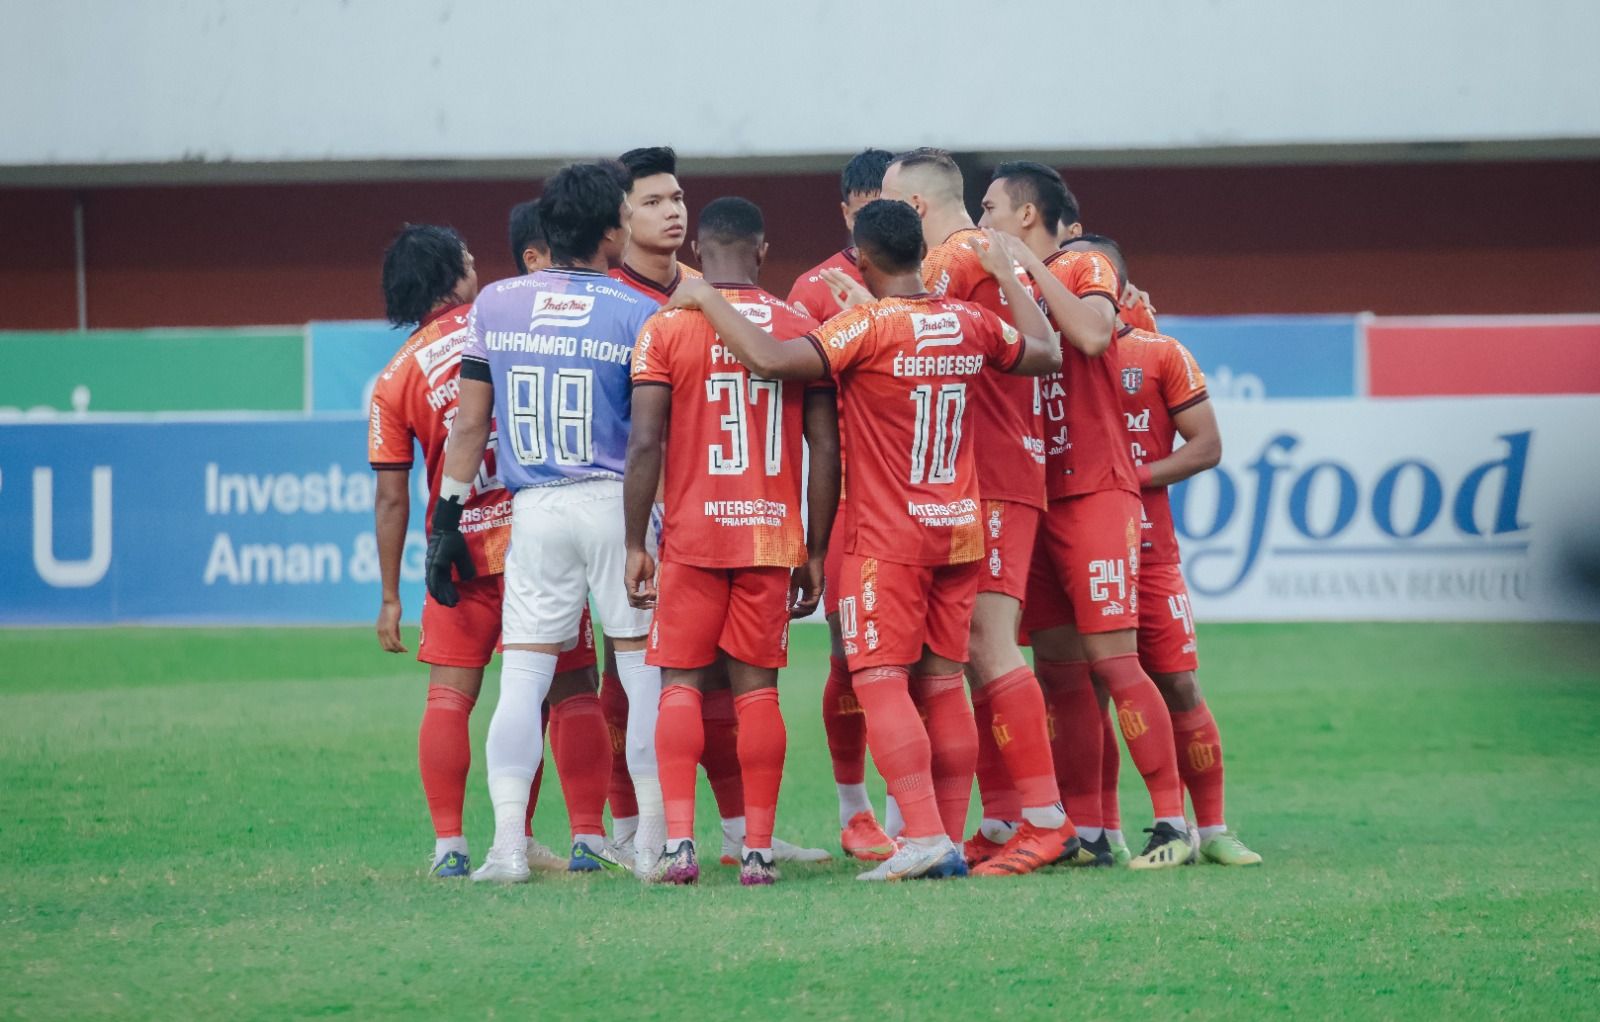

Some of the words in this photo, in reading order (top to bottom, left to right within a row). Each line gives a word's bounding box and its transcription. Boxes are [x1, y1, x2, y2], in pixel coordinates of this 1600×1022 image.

[829, 318, 870, 349] Vidio
[507, 365, 594, 466] 88
[705, 372, 783, 476] 37
[909, 383, 967, 485] 10
[204, 532, 342, 586] Aman
[1088, 559, 1125, 602] 24
[838, 595, 858, 640] 10
